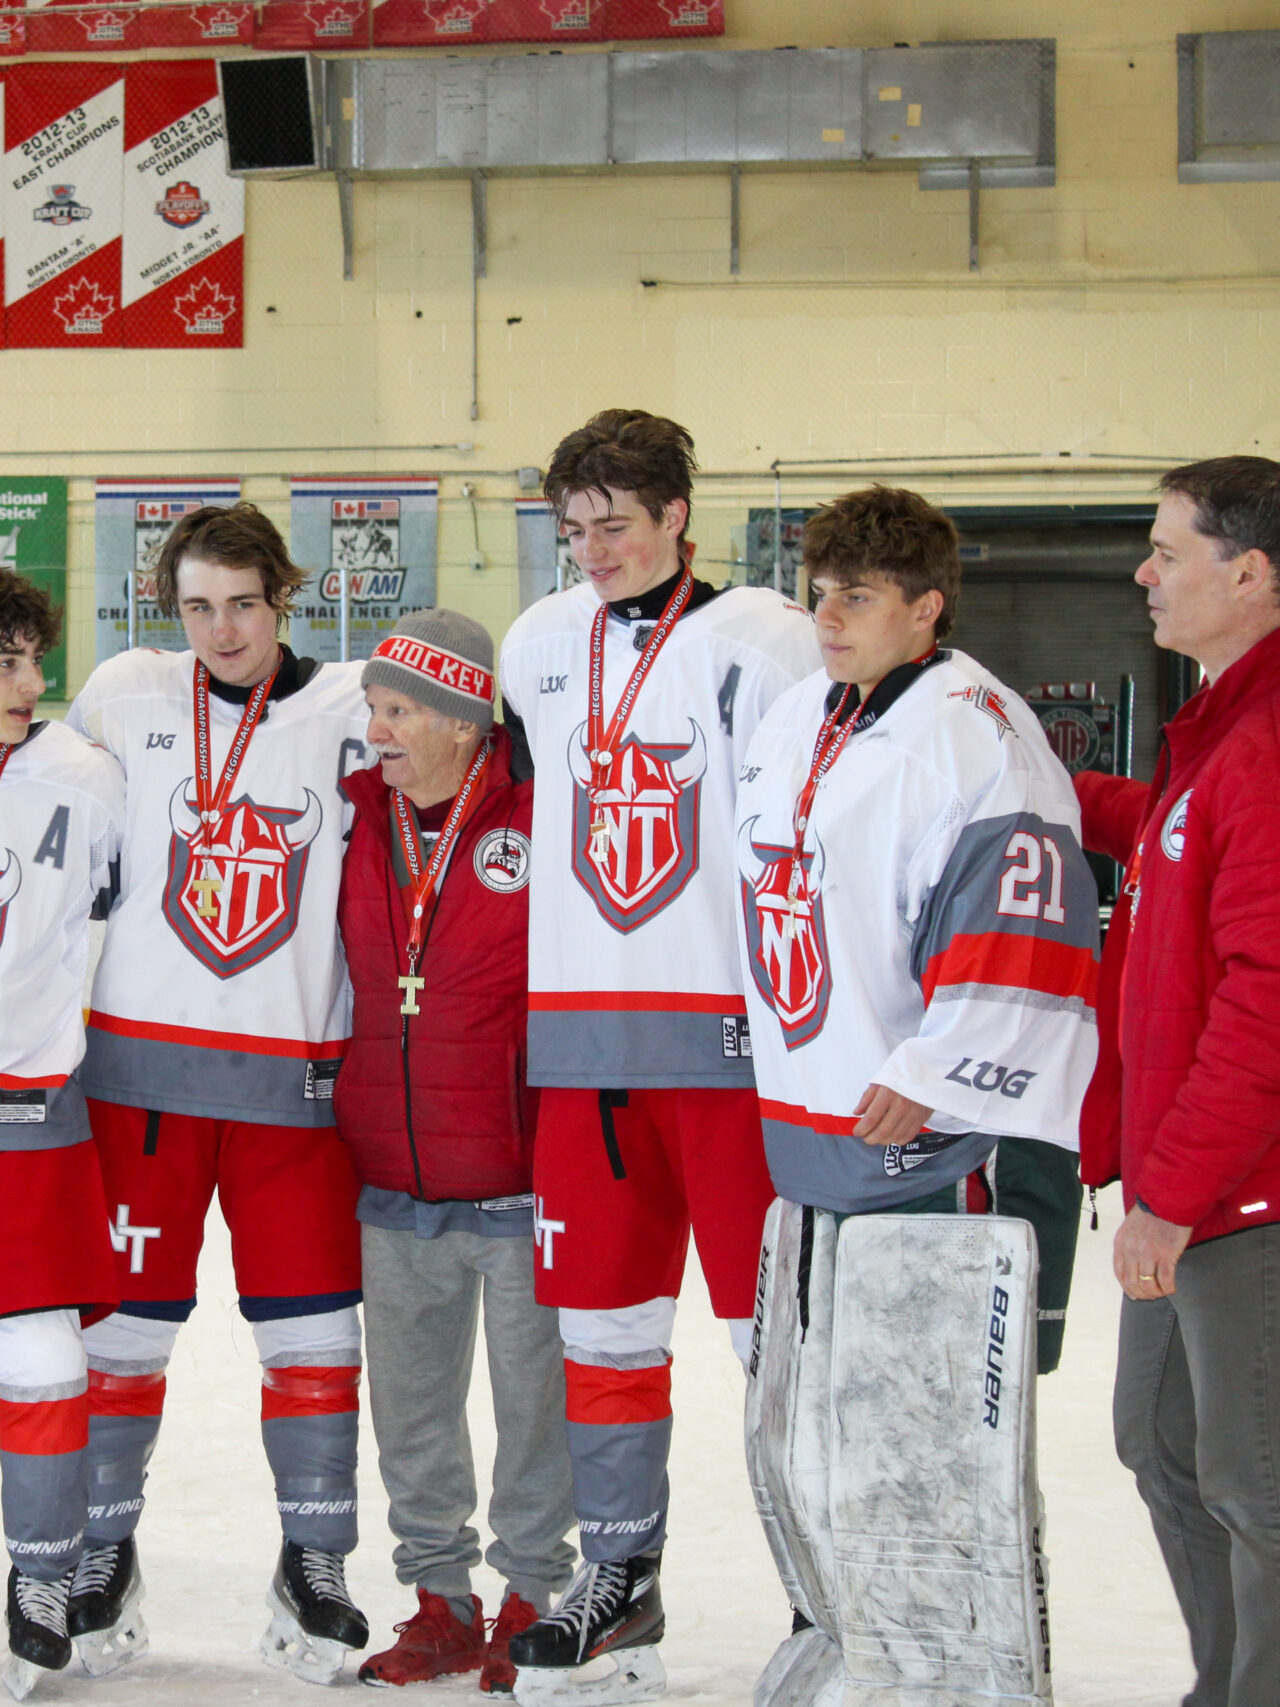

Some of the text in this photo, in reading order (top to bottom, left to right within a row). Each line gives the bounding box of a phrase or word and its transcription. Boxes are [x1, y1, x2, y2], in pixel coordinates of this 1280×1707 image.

[20, 107, 87, 156] 2012-13
[31, 122, 88, 163] KRAFT CUP
[150, 106, 210, 150] 2012-13
[13, 115, 120, 190] EAST CHAMPIONS
[137, 133, 197, 173] SCOTIABANK
[26, 246, 70, 278] BANTAM
[27, 243, 97, 290] NORTH TORONTO
[140, 251, 179, 280] MIDGET
[152, 240, 223, 287] NORTH TORONTO
[0, 507, 37, 520] Stick
[293, 606, 392, 619] CHALENGE
[389, 638, 485, 696] HOCKEY
[617, 572, 692, 722] REGIONAL CHAMPIONSHIPS
[592, 652, 601, 716] REGIONAL
[198, 690, 208, 780] CHAMPIONSHIPS
[225, 726, 250, 782] REGIONAL
[34, 804, 70, 871] A
[401, 819, 419, 876] REGIONAL
[429, 780, 471, 876] CHAMPIONSHIPS
[197, 859, 276, 942] NT
[997, 831, 1065, 926] 21
[724, 1018, 737, 1055] LUG
[945, 1058, 1038, 1099] LUG
[886, 1144, 900, 1170] LUG
[750, 1246, 770, 1380] BAUER
[983, 1285, 1009, 1430] BAUER
[298, 1501, 352, 1515] OMNIA
[603, 1511, 660, 1535] VINCIT
[17, 1538, 70, 1555] OMNIA
